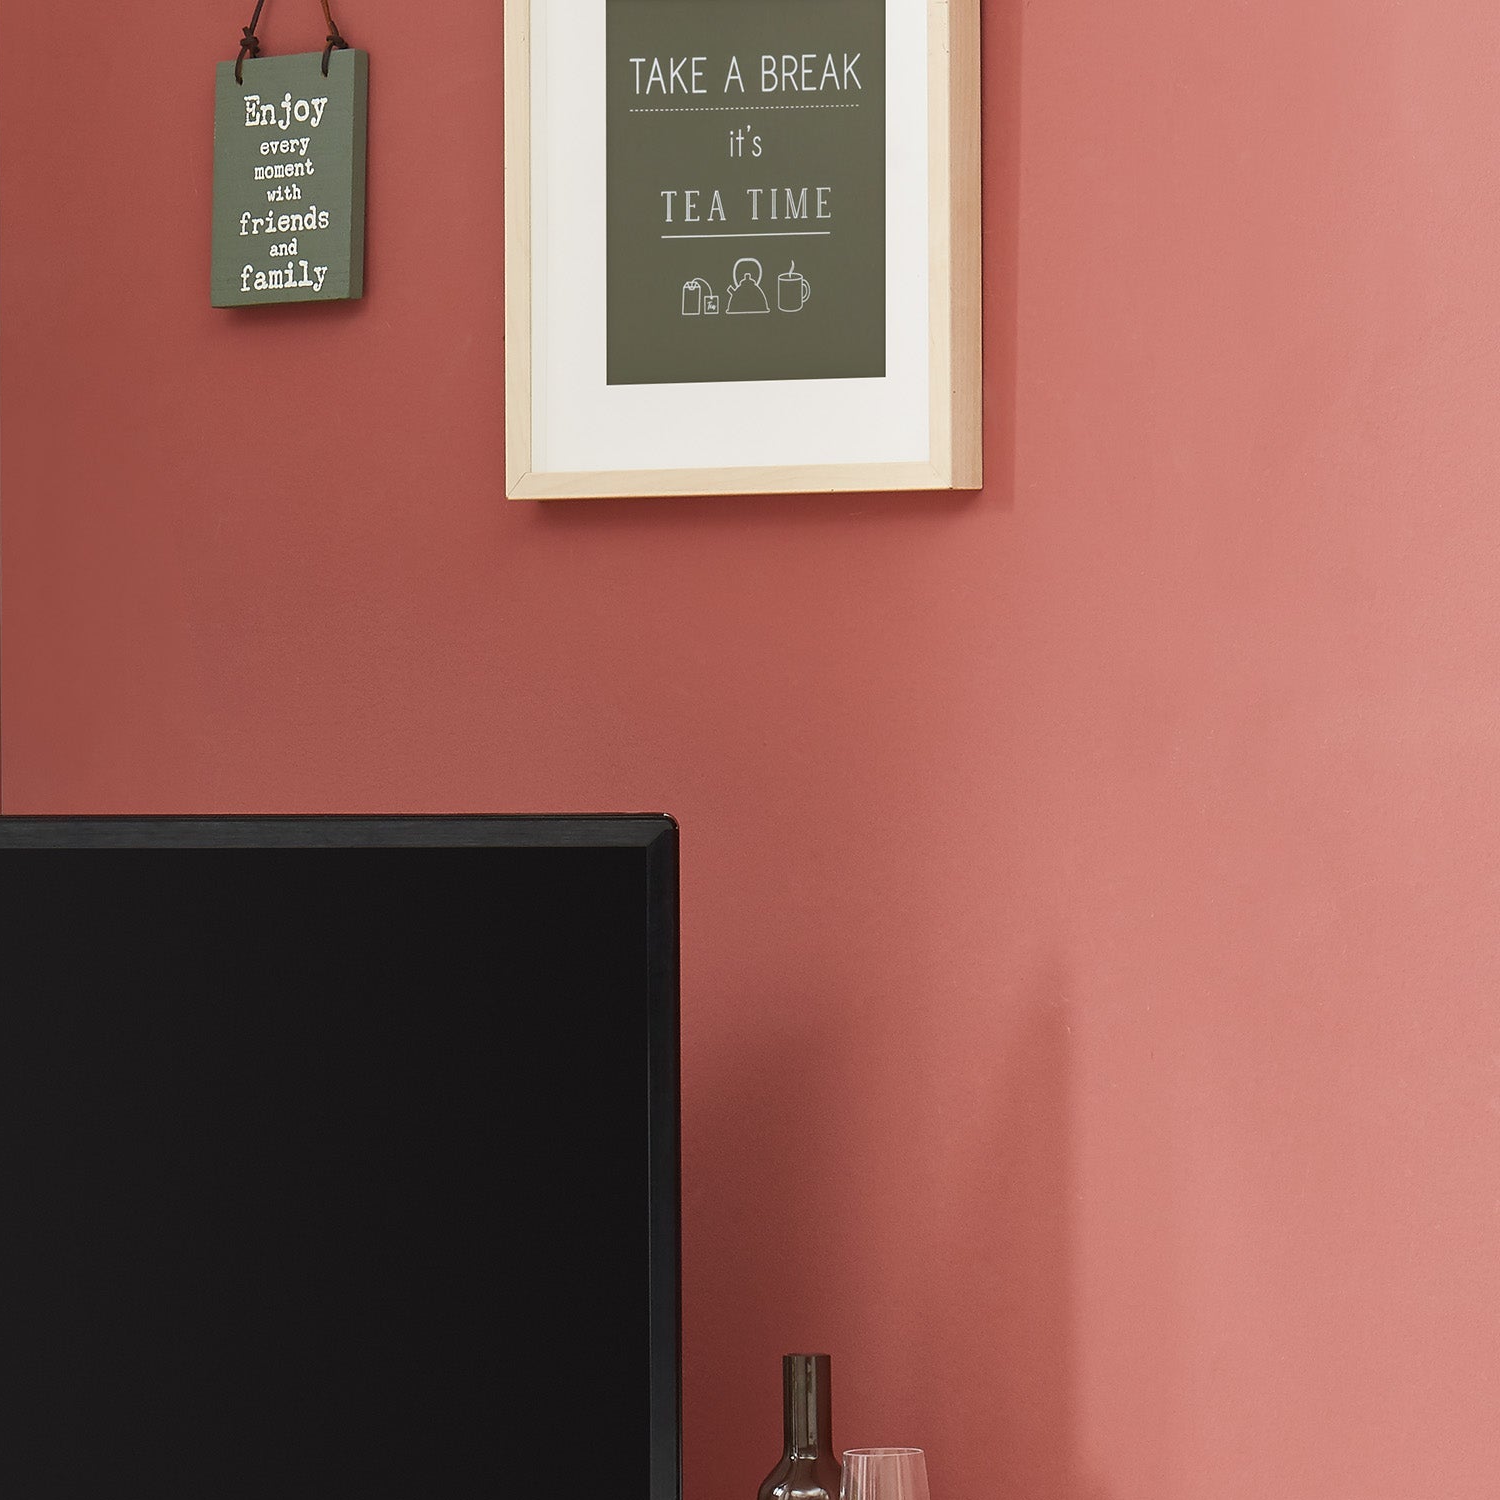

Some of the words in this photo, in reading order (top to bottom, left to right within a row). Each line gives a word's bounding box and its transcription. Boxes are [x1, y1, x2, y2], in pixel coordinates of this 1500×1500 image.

[629, 56, 708, 95] TAKE
[723, 55, 745, 93] A
[761, 52, 862, 93] BREAK
[243, 92, 328, 131] Enjoy
[259, 136, 311, 156] every
[729, 124, 762, 158] it's
[254, 157, 315, 181] moment
[266, 183, 302, 203] with
[660, 189, 727, 223] TEA
[746, 186, 832, 221] TIME
[239, 205, 330, 236] friends
[269, 237, 298, 258] and
[240, 260, 328, 292] family
